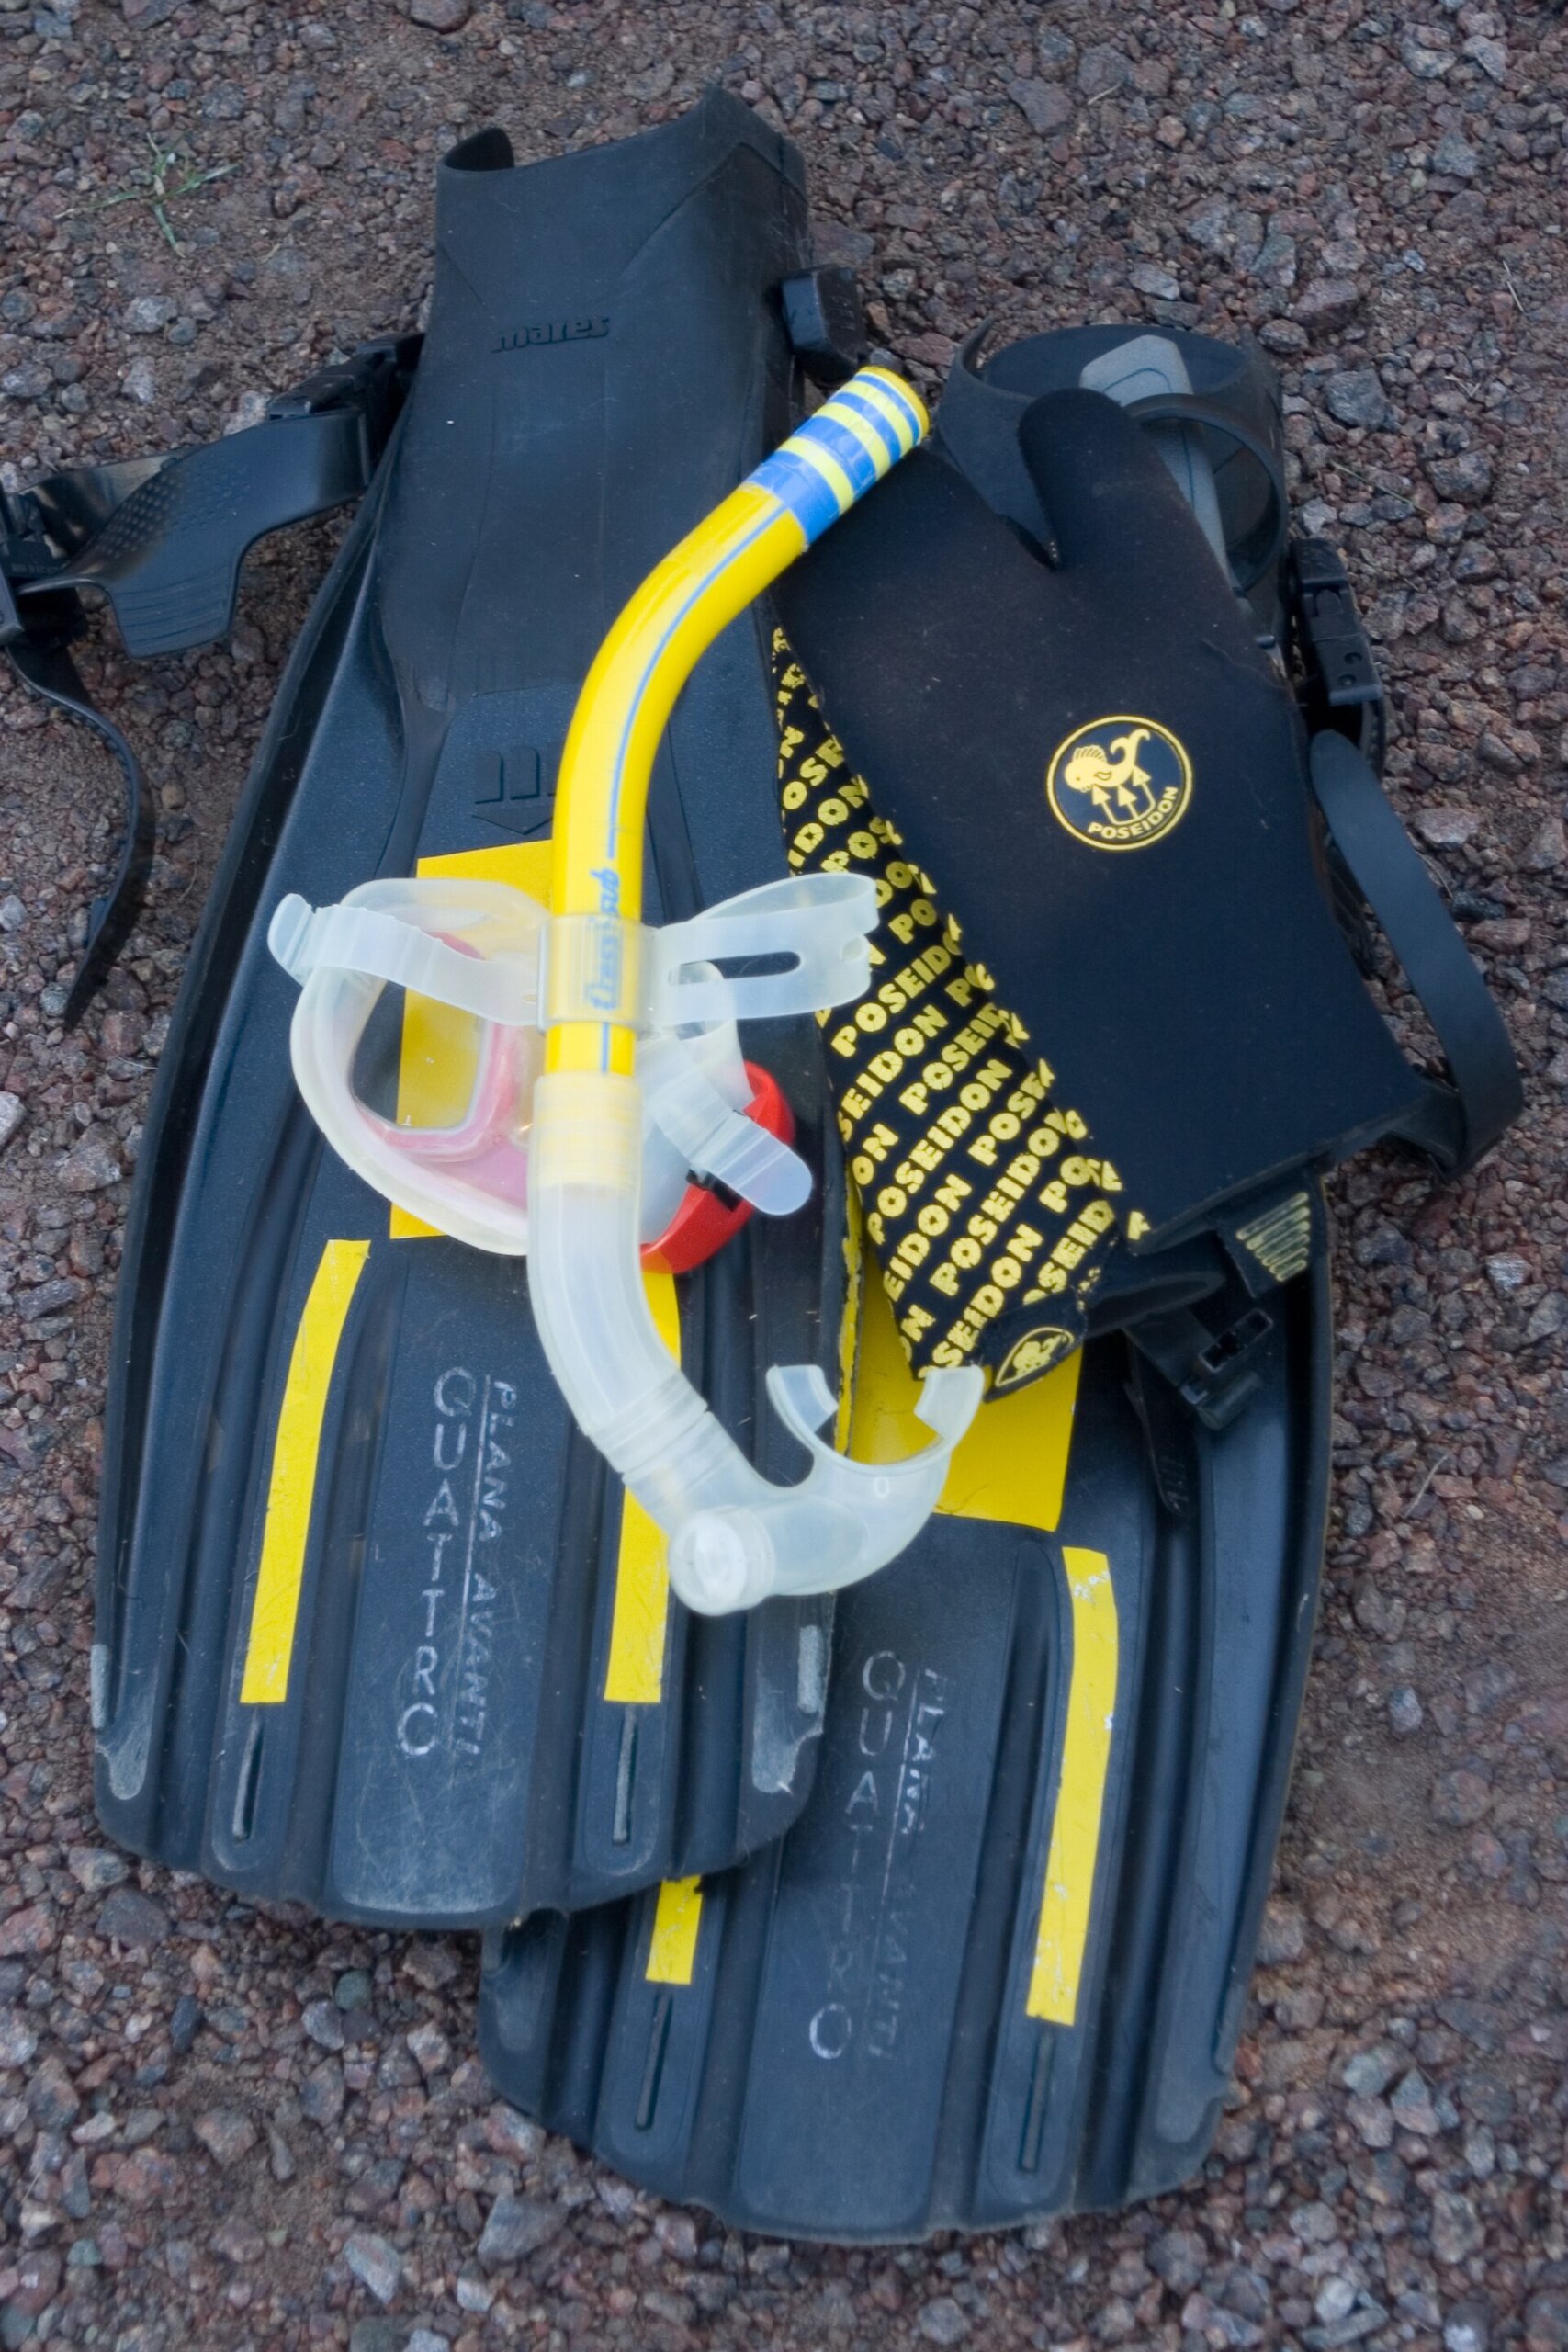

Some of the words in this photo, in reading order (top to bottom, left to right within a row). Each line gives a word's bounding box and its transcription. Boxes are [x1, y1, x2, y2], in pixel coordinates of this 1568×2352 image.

[491, 317, 610, 354] mares
[1088, 786, 1179, 840] POSEIDON
[867, 1059, 1012, 1245] POSEIDON
[919, 1224, 1043, 1378] SEIDON
[479, 1381, 517, 1542] PLANA
[395, 1366, 476, 1756] QUATTRO
